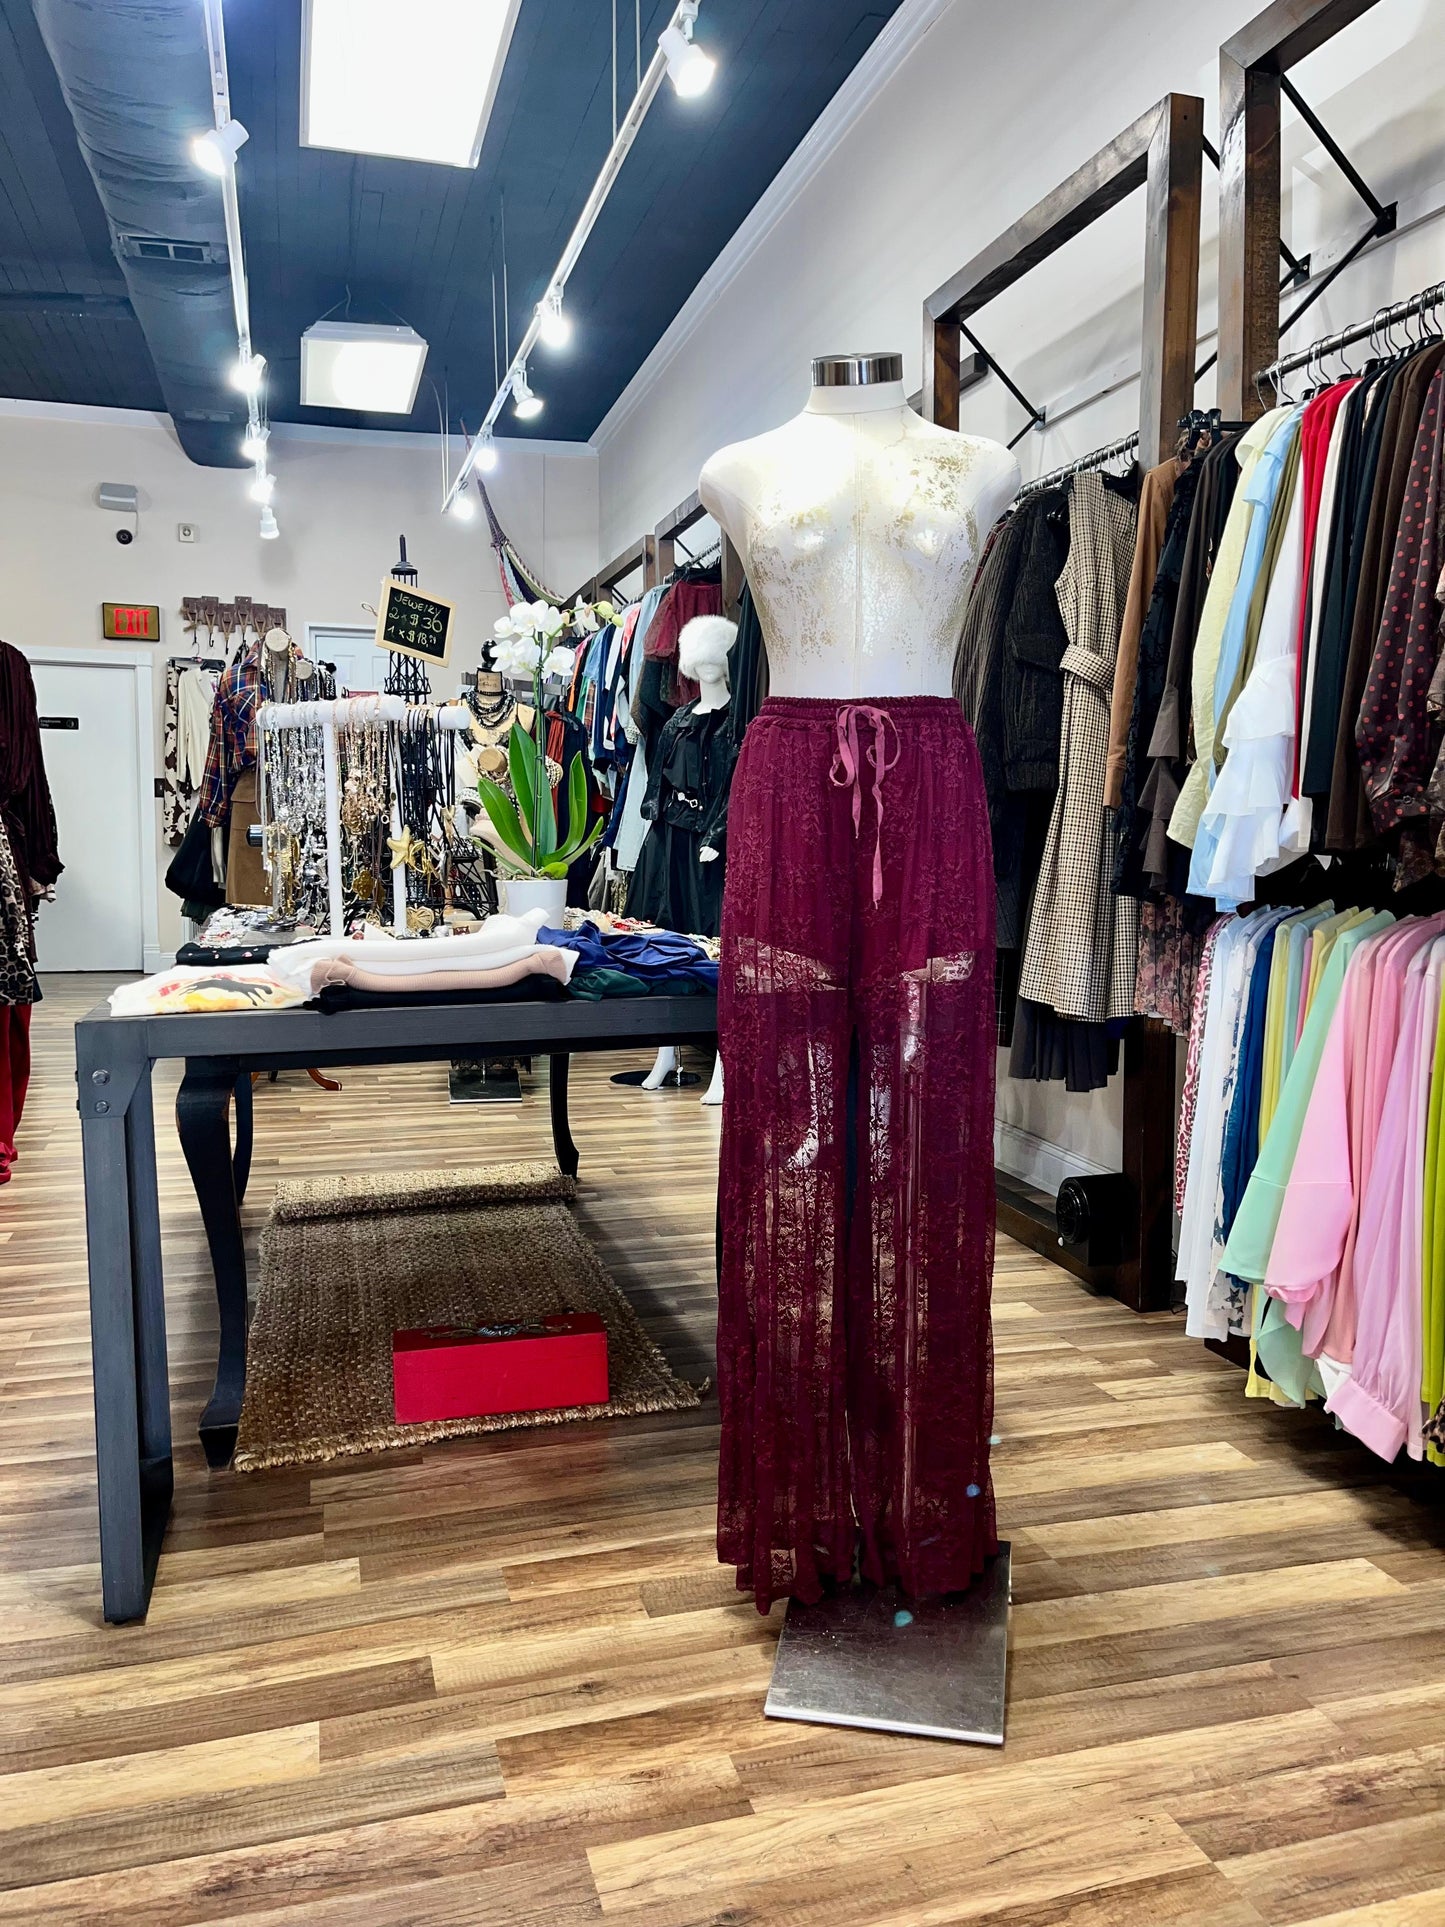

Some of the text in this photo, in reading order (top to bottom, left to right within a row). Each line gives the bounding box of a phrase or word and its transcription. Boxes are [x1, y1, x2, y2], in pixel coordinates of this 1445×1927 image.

[388, 607, 400, 620] 2
[114, 608, 149, 635] EXIT
[387, 625, 395, 637] 1
